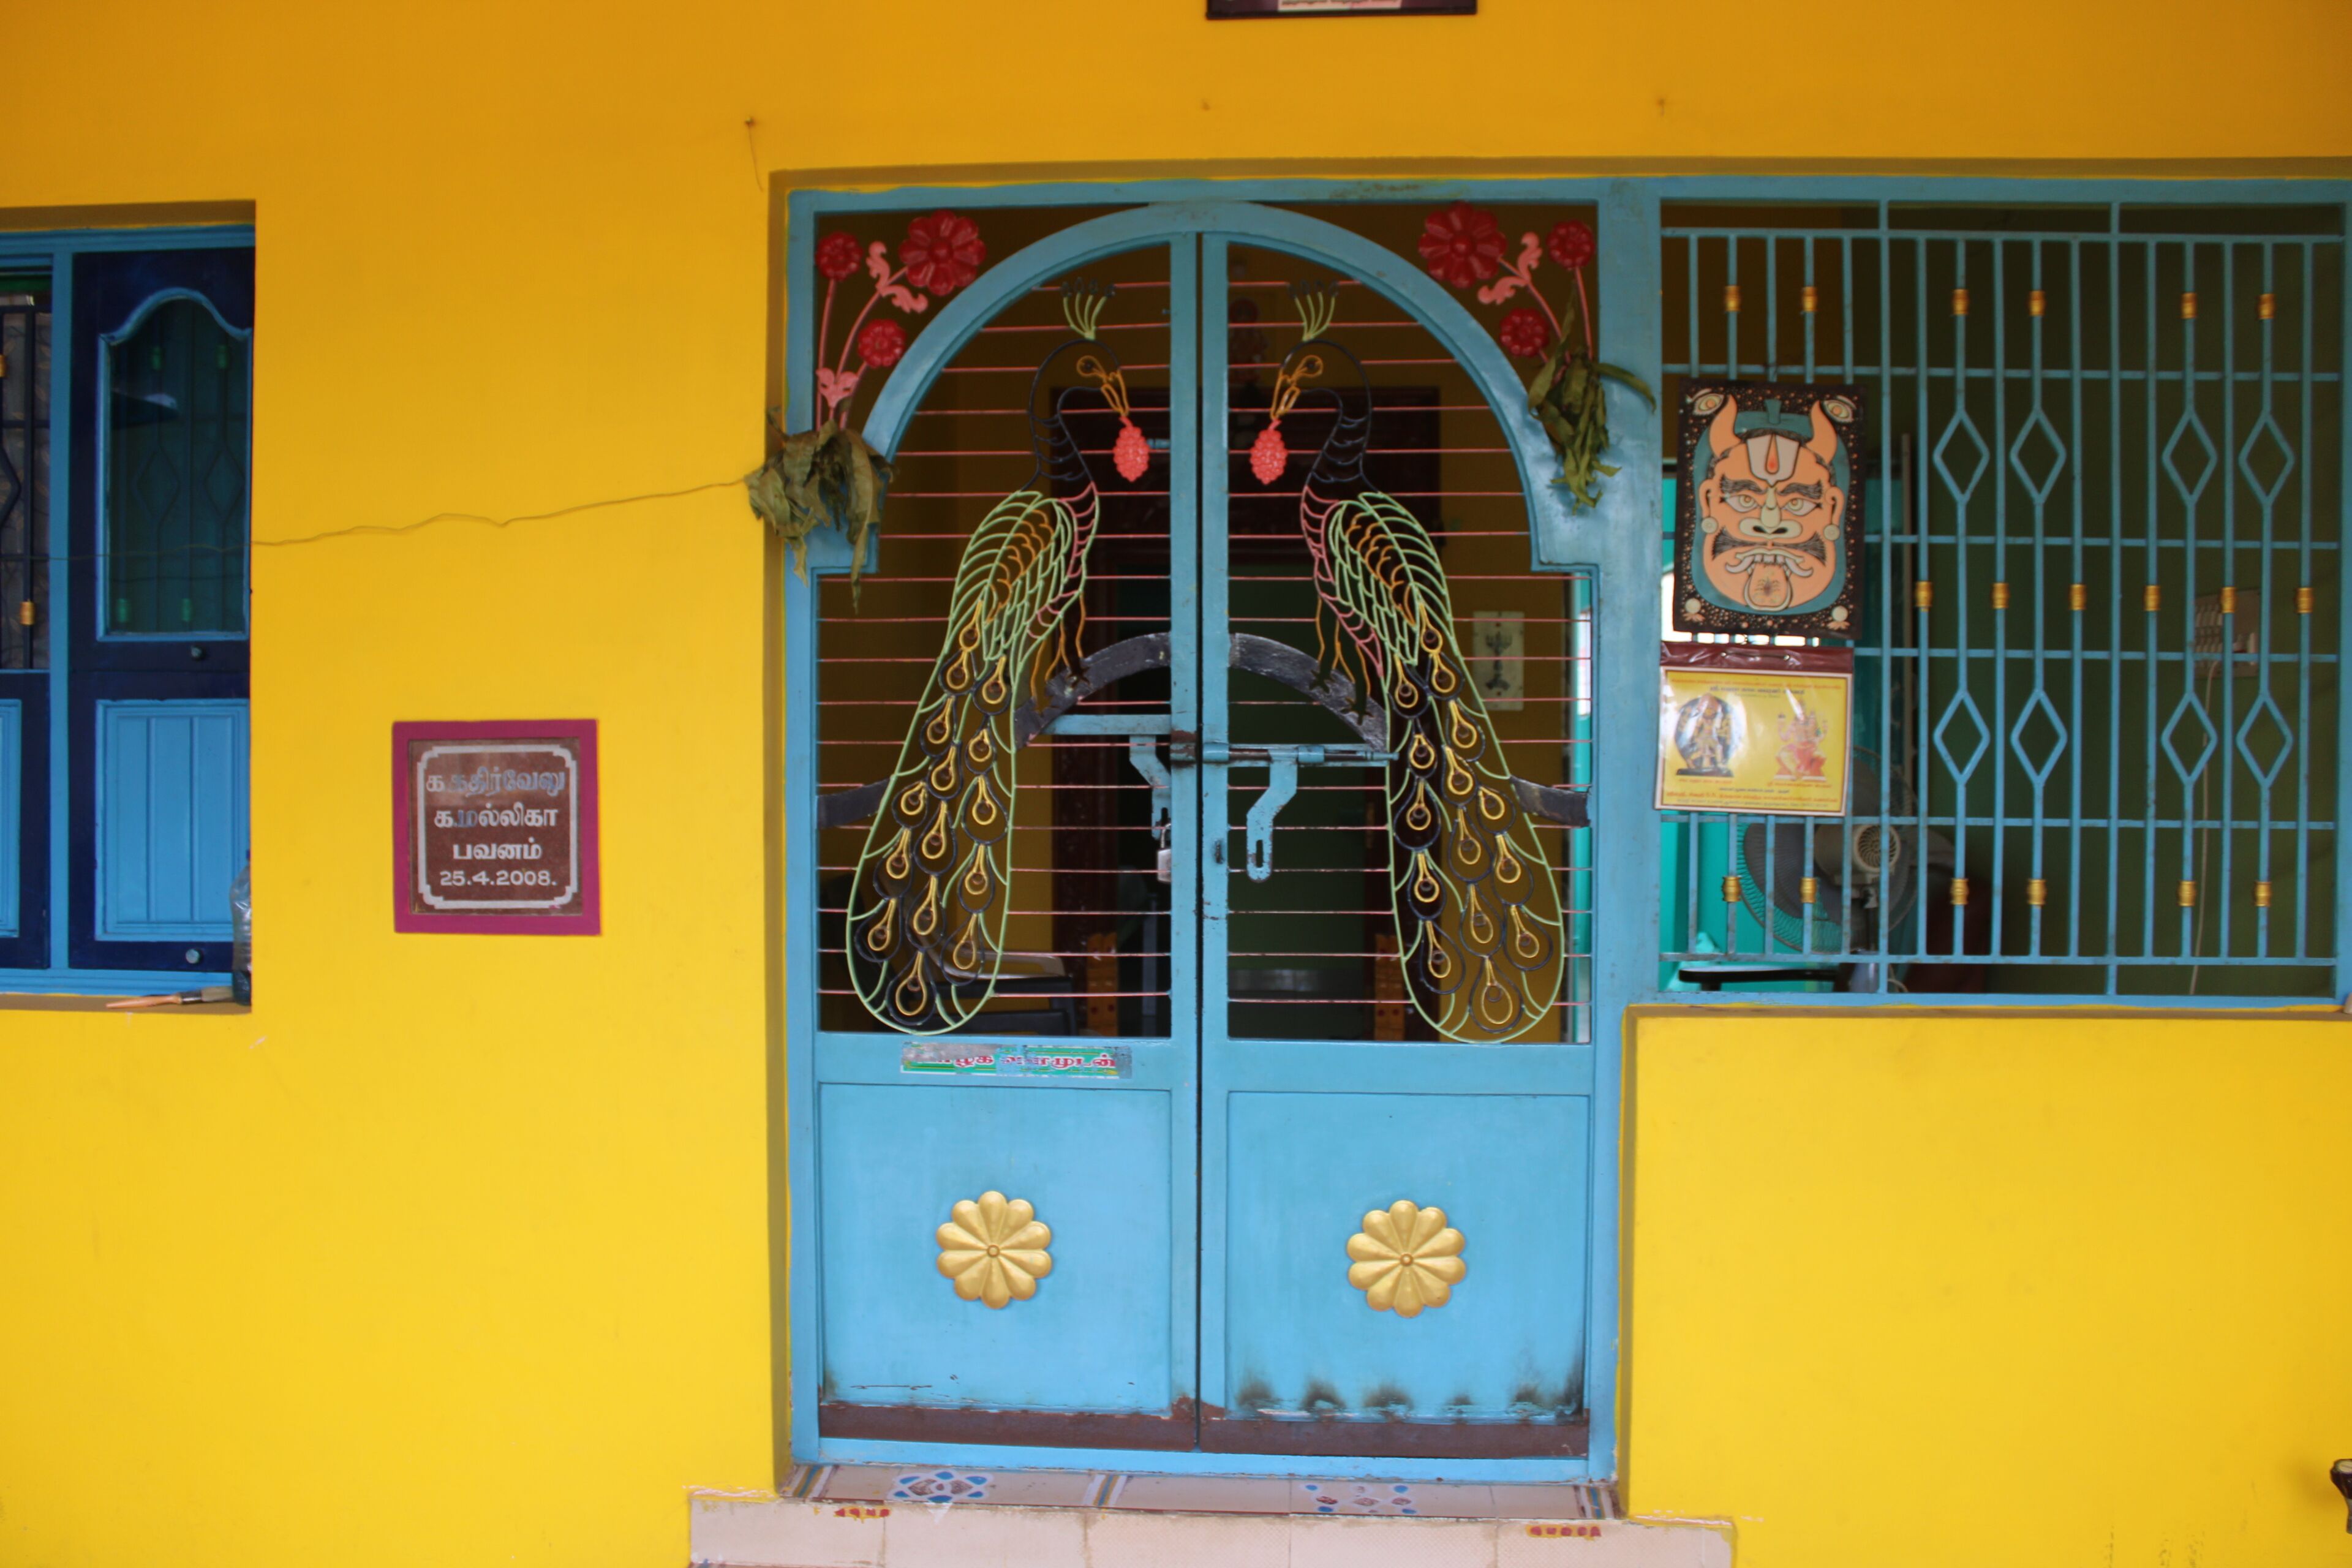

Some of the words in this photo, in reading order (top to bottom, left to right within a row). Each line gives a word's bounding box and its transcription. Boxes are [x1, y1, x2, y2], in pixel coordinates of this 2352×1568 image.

[434, 802, 558, 827] க.மல்லிகா
[453, 837, 542, 860] பவனம்
[440, 870, 557, 886] 25.4.2008.
